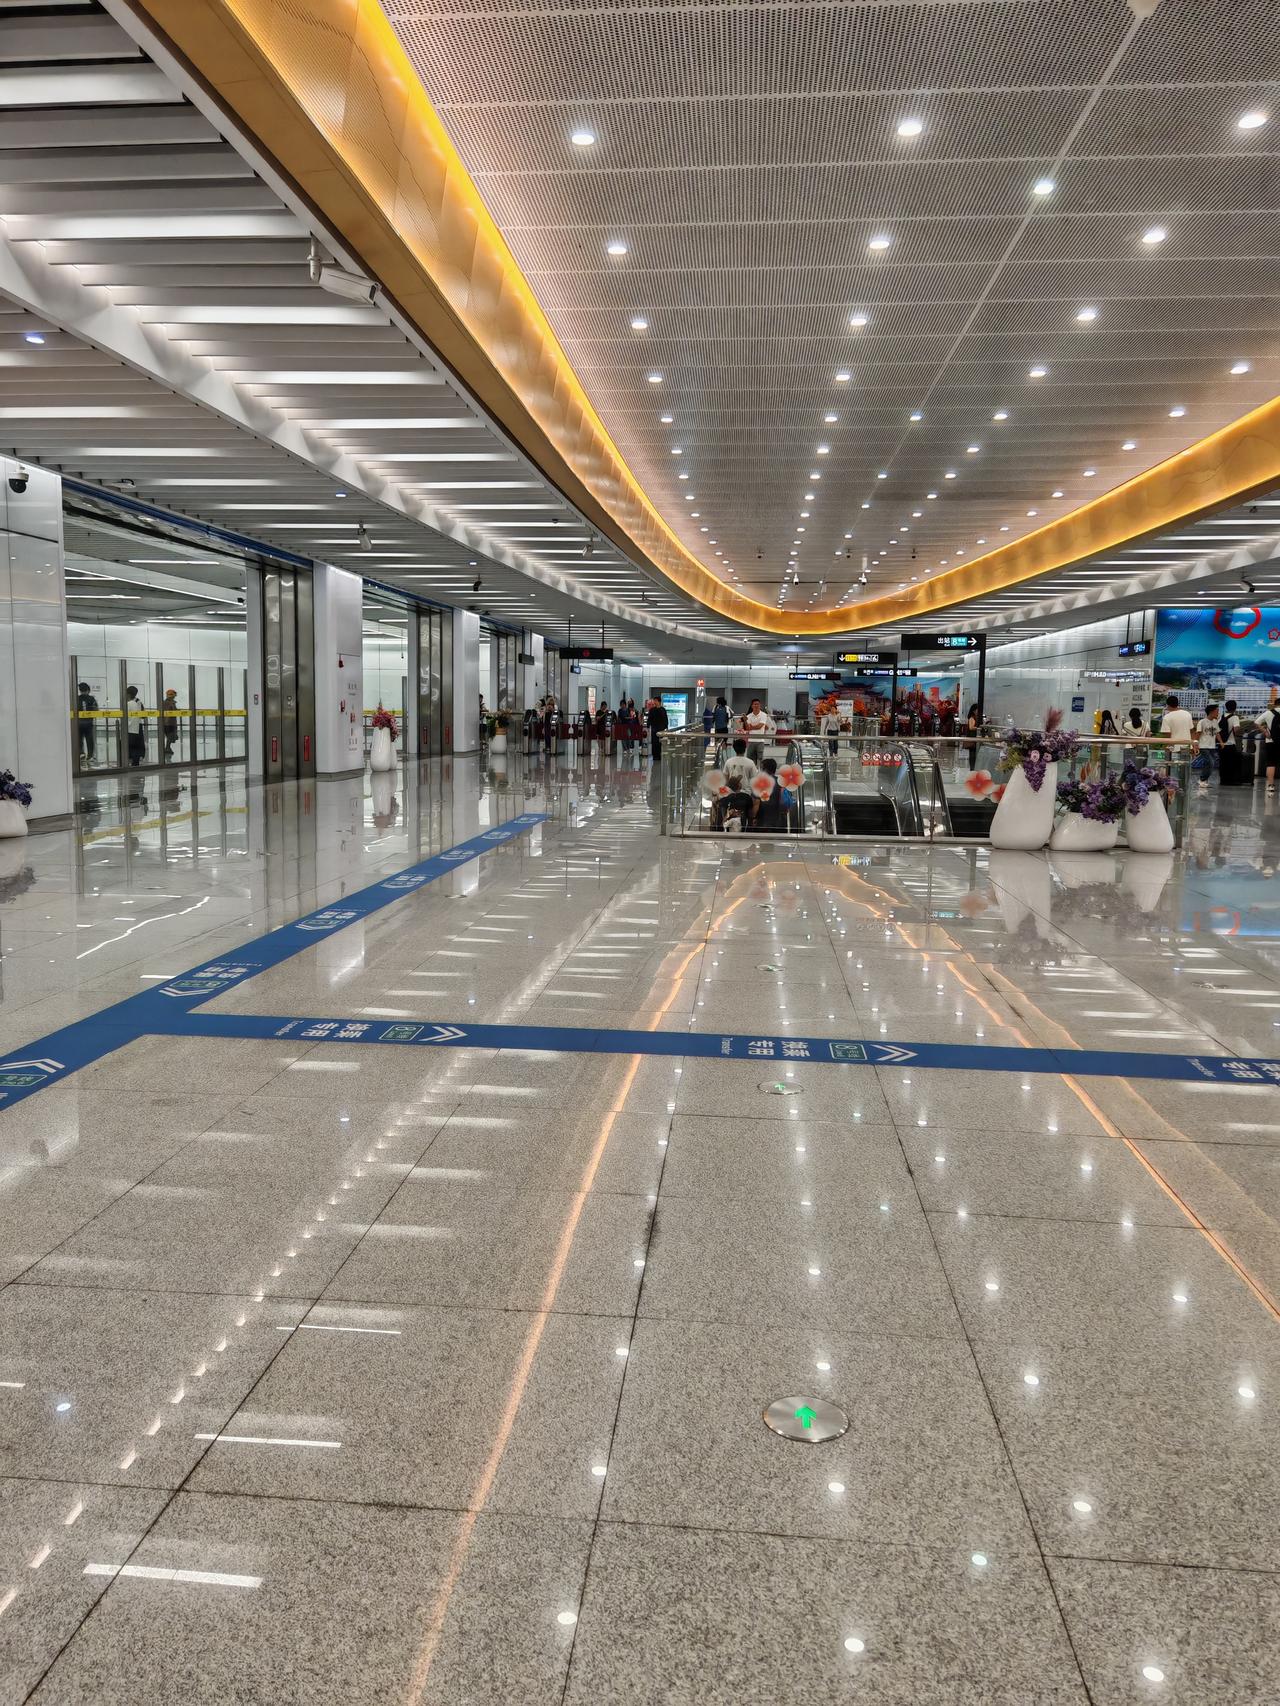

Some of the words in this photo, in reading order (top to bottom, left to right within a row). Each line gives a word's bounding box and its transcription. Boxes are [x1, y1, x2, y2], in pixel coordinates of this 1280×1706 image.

[721, 1037, 733, 1055] Transfer
[748, 1040, 775, 1056] 专用
[781, 1040, 810, 1057] 换乘
